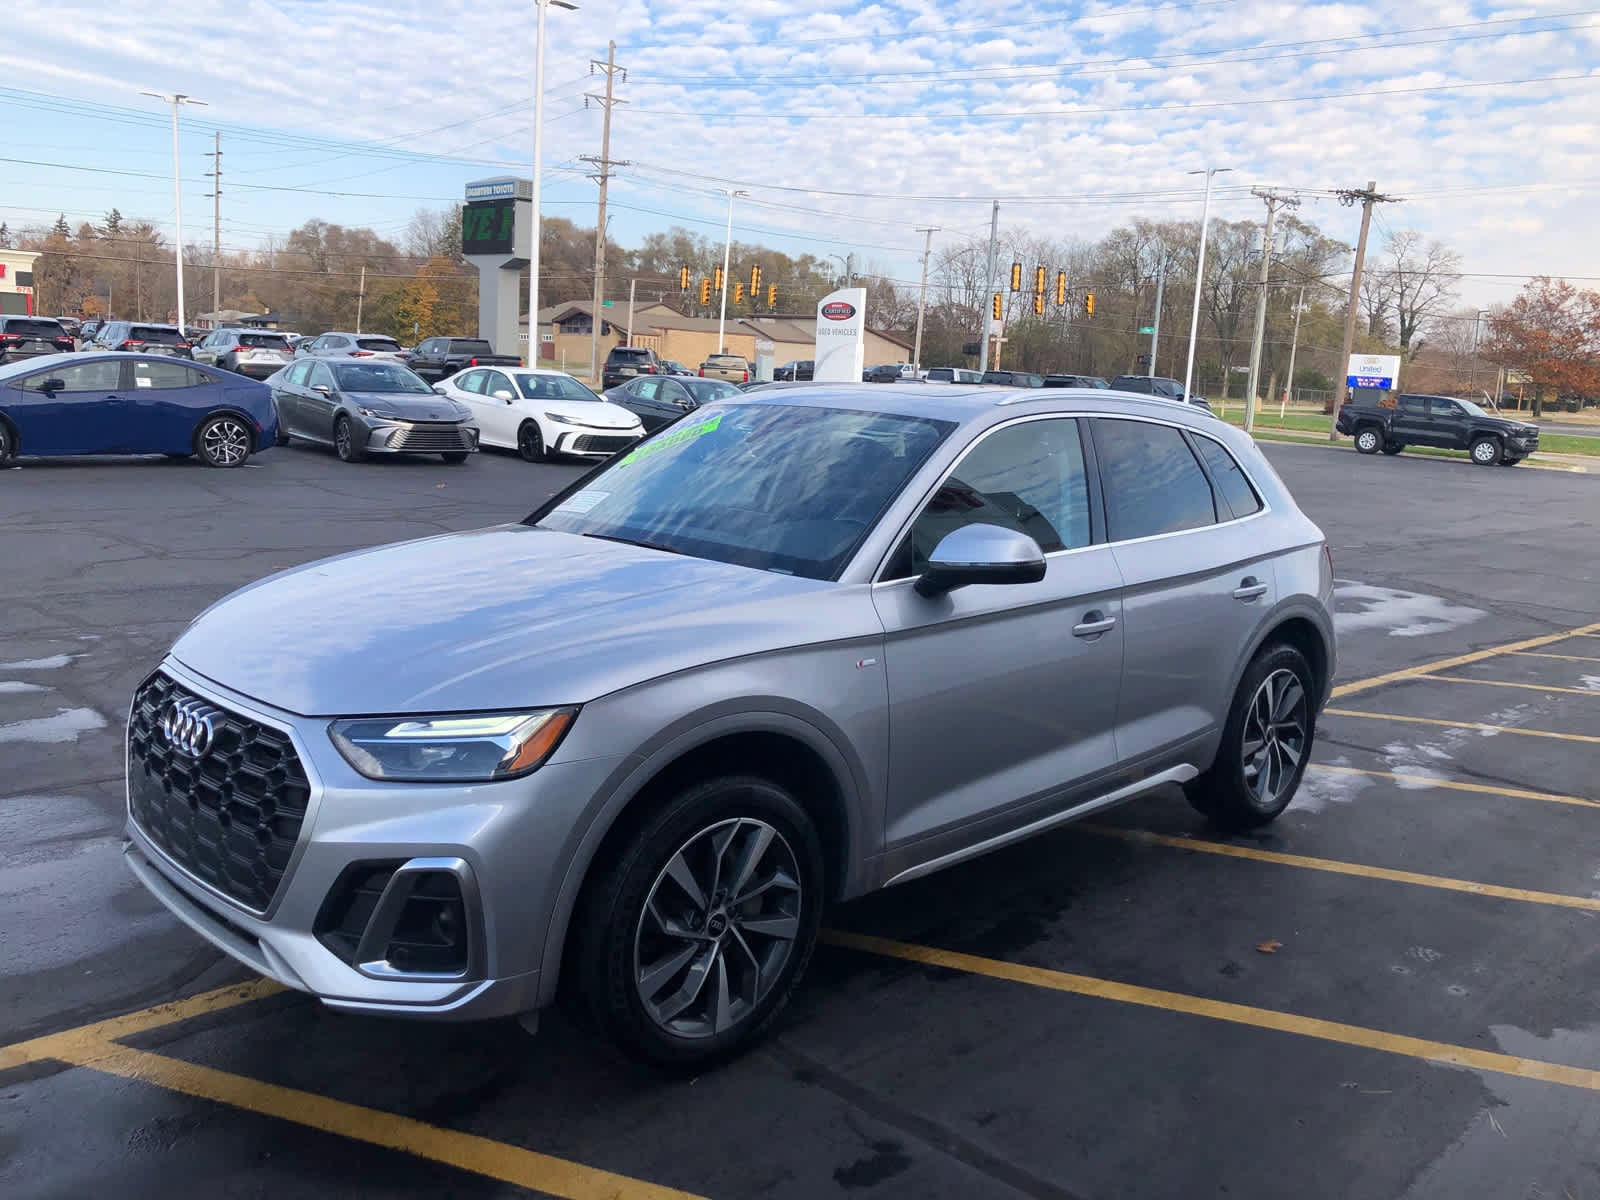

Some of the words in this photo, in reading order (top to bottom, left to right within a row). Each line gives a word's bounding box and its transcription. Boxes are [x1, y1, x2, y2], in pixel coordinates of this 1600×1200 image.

[493, 183, 514, 194] TOYOTA
[818, 327, 830, 336] USED
[832, 328, 857, 336] VEHICLES
[1360, 365, 1382, 373] United
